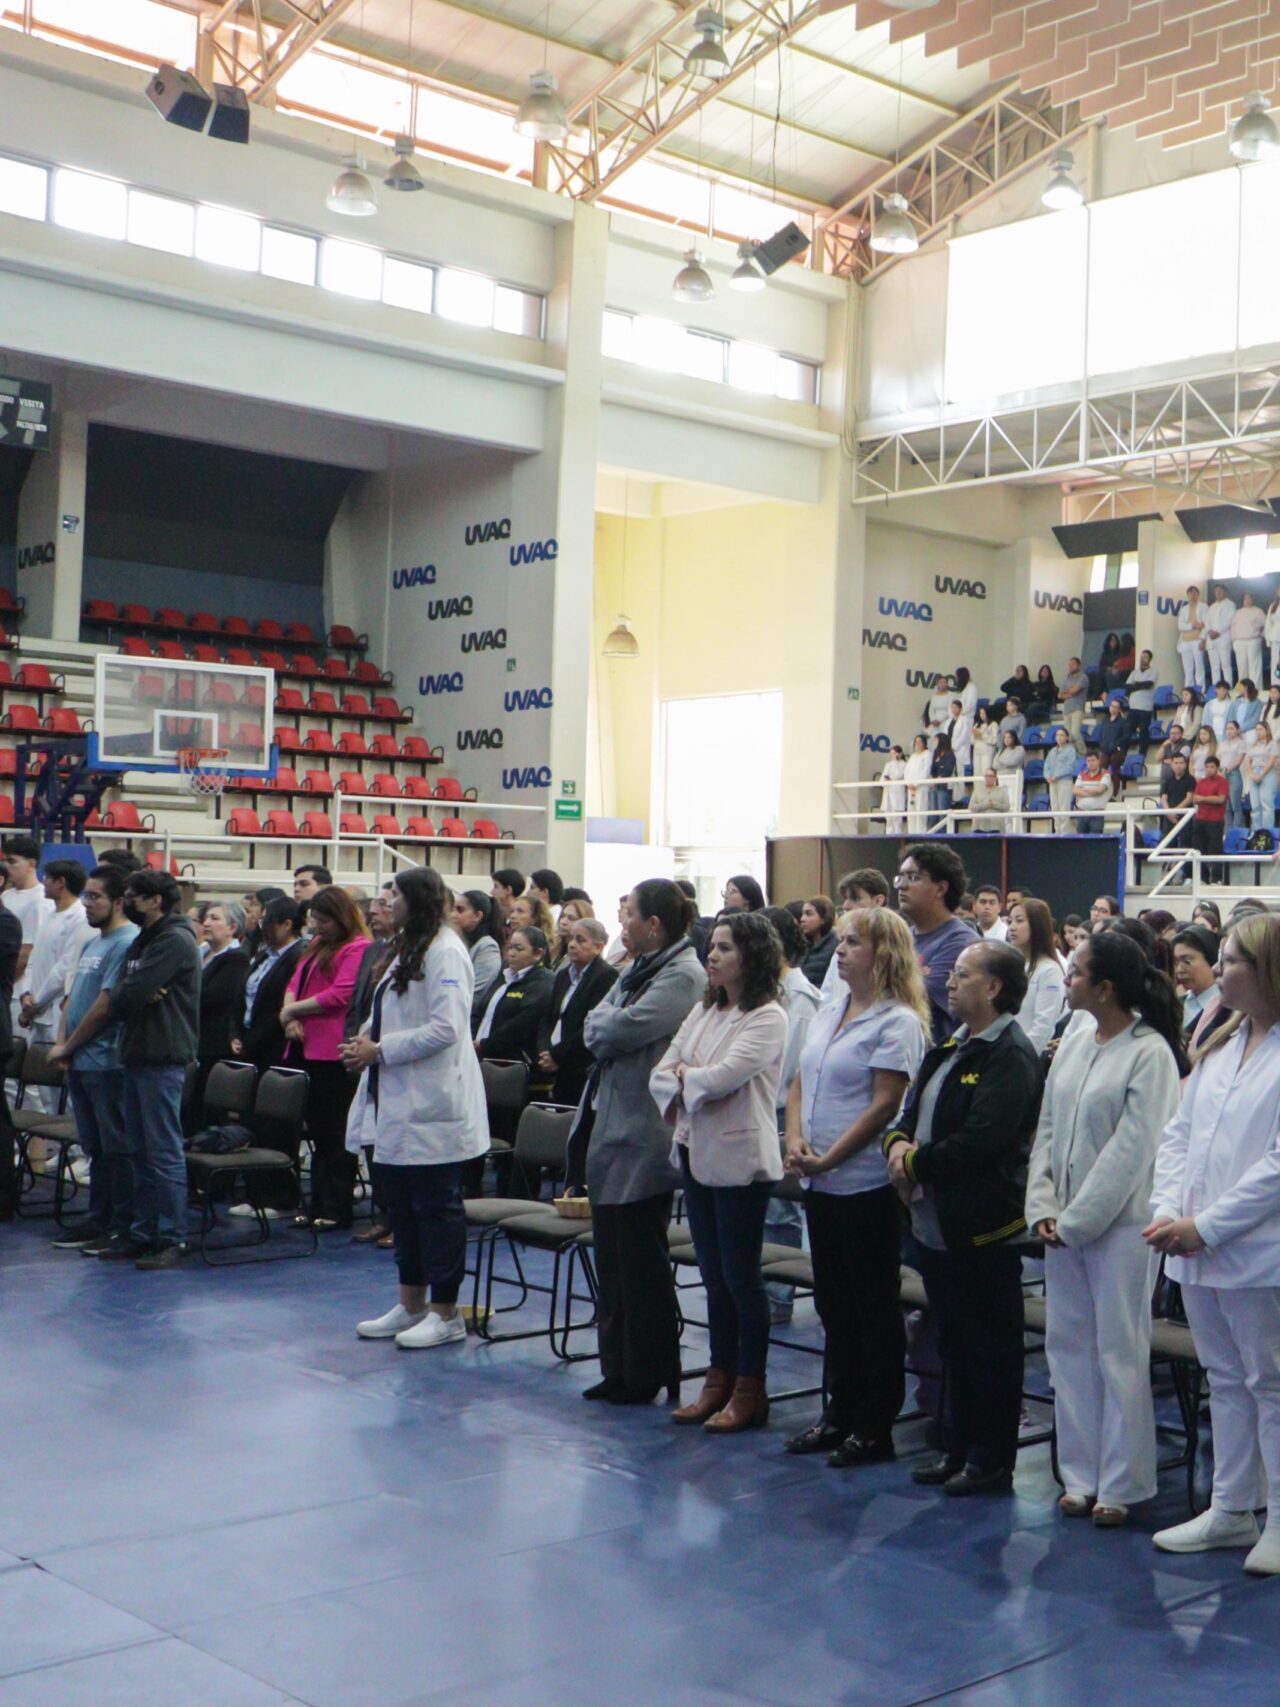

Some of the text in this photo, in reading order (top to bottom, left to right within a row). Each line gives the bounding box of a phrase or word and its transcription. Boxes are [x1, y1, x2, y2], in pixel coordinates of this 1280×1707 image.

[465, 519, 511, 545] UVAQ
[18, 541, 55, 569] UVAQ
[509, 538, 558, 566] UVAQ
[393, 564, 436, 589] UVAQ
[935, 575, 986, 599] UVAQ
[427, 595, 473, 620] UVAQ
[879, 597, 933, 622] UVAQ
[1034, 590, 1083, 615] UVAQ
[460, 628, 507, 653] UVAQ
[418, 671, 463, 695] UVAQ
[504, 687, 553, 712] UVAQ
[456, 728, 503, 750] UVAQ
[502, 766, 552, 789] UVAQ
